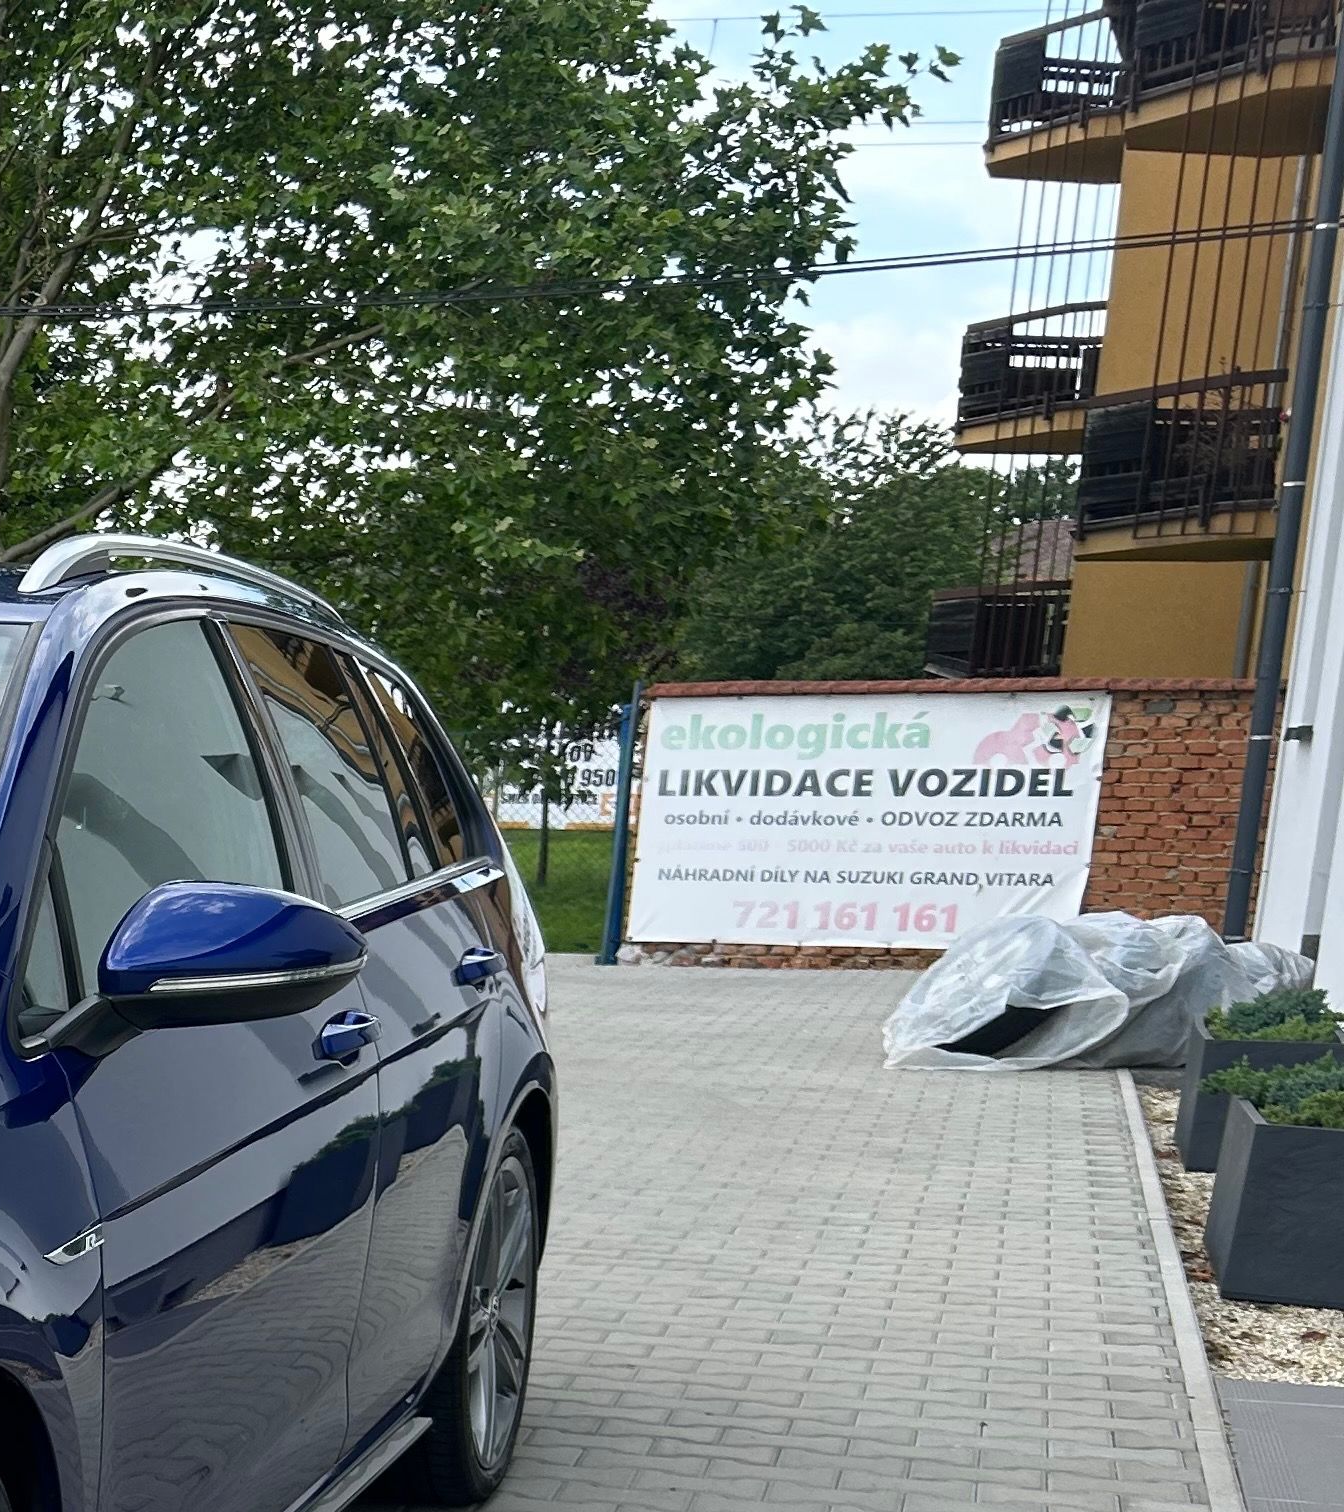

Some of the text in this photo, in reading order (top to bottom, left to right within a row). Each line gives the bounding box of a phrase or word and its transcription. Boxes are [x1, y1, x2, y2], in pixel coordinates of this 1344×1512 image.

[660, 711, 930, 760] ekologická
[658, 767, 1074, 798] LIKVIDACE VOZIDEL
[663, 809, 1064, 827] osobní dodávkové ODVOZ ZDARMA
[888, 840, 931, 855] vaše
[933, 842, 975, 856] auto
[982, 840, 993, 855] k
[999, 840, 1079, 856] likvidaci
[658, 864, 1056, 887] NÁHRADNÍ DÍLY NA SUZUKI GRAND VITARA
[732, 900, 958, 933] 721 161 161
